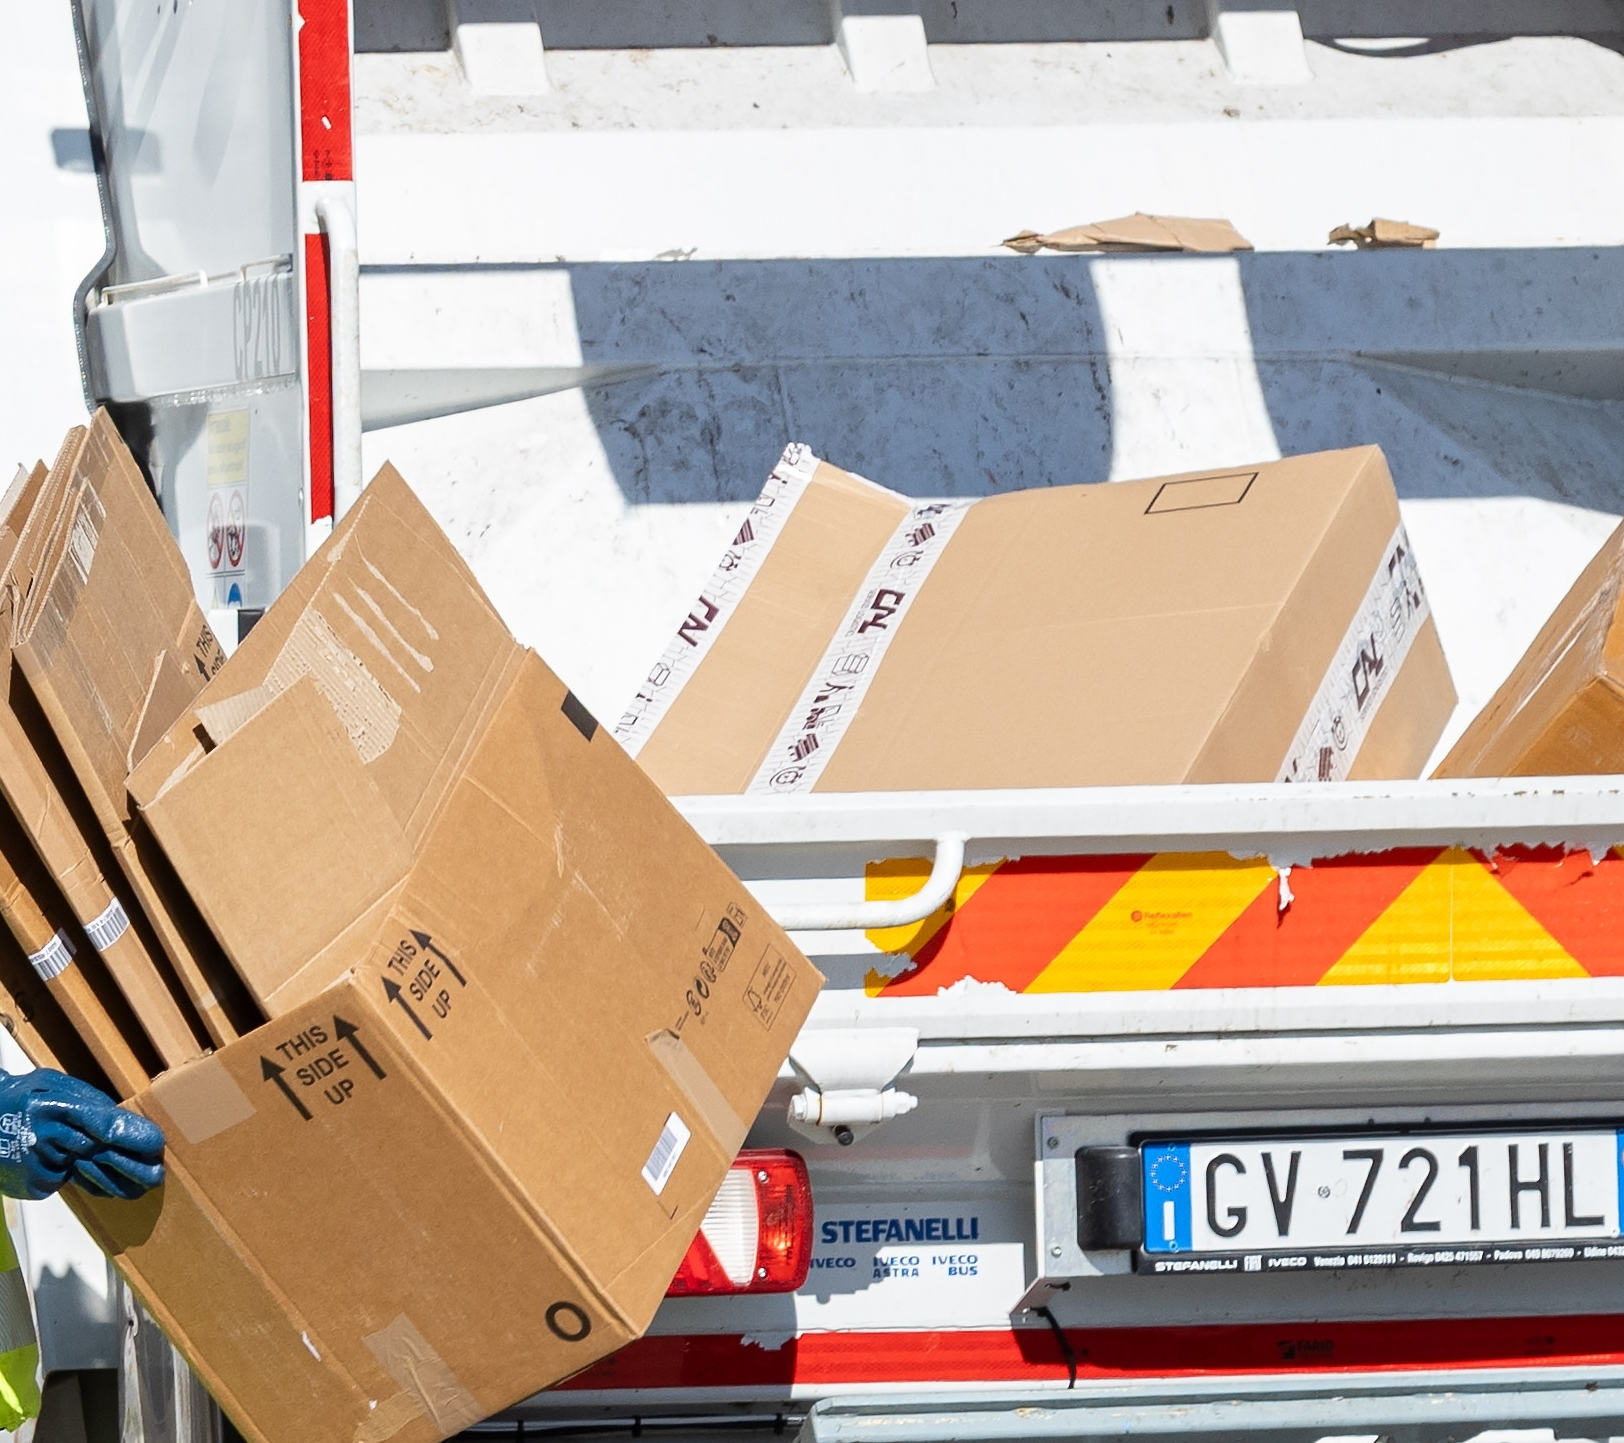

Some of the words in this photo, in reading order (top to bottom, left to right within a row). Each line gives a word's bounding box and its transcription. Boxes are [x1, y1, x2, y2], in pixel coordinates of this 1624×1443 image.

[387, 939, 418, 976] THIS
[409, 959, 441, 1002] SIDE
[432, 989, 452, 1019] UP
[275, 1025, 328, 1062] THIS
[296, 1048, 350, 1087] SIDE
[323, 1078, 354, 1105] UP
[1205, 1150, 1302, 1238] GV
[821, 1217, 979, 1244] STEFANELLI
[810, 1257, 857, 1269] IVECO
[872, 1255, 921, 1267] IVECO
[872, 1267, 920, 1278] ASTRA
[932, 1254, 979, 1265] IVECO
[948, 1266, 979, 1276] BUS
[1155, 1259, 1238, 1272] STEFANELLI
[1268, 1256, 1307, 1268] IVECO
